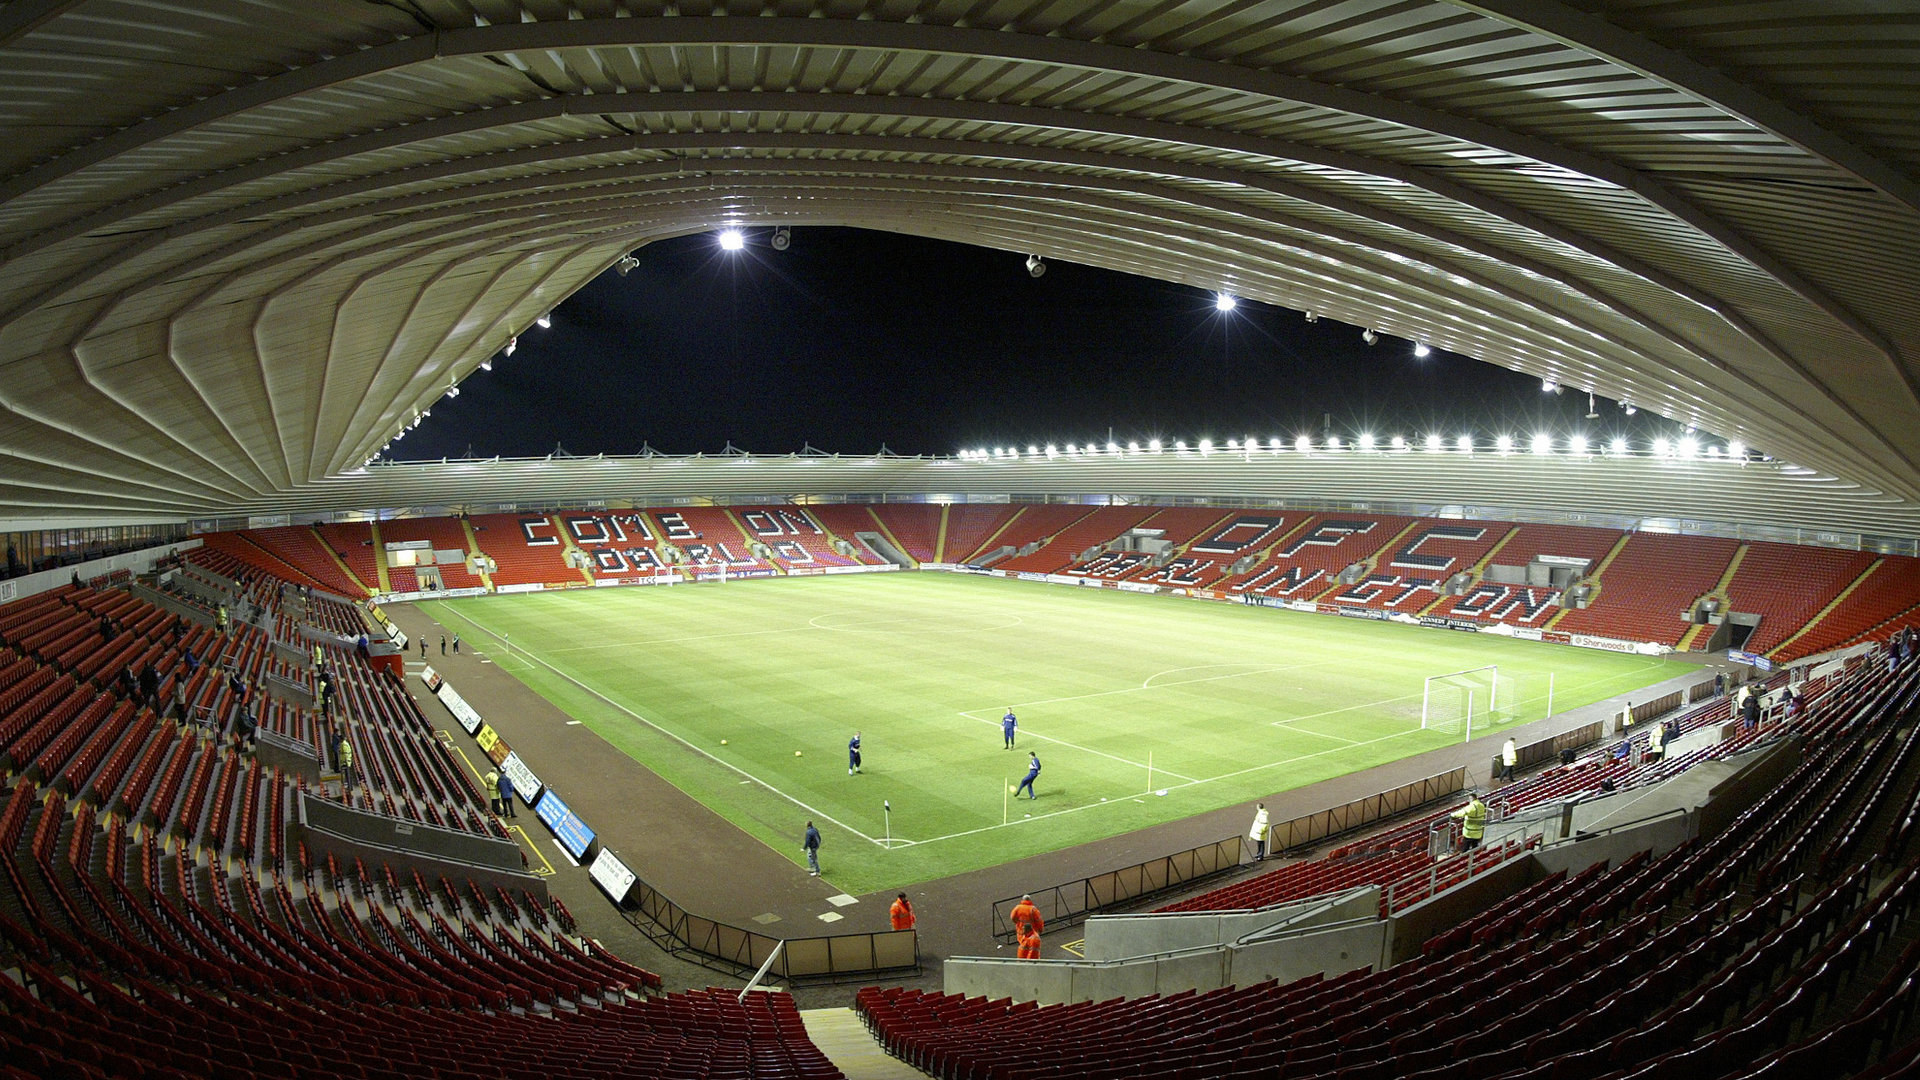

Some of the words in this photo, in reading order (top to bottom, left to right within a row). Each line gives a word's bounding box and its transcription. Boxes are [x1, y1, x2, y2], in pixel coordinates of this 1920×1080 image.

[518, 512, 697, 546] COME
[742, 510, 823, 536] ON
[1192, 516, 1487, 571] DFC
[1582, 637, 1627, 651] Sherwoods
